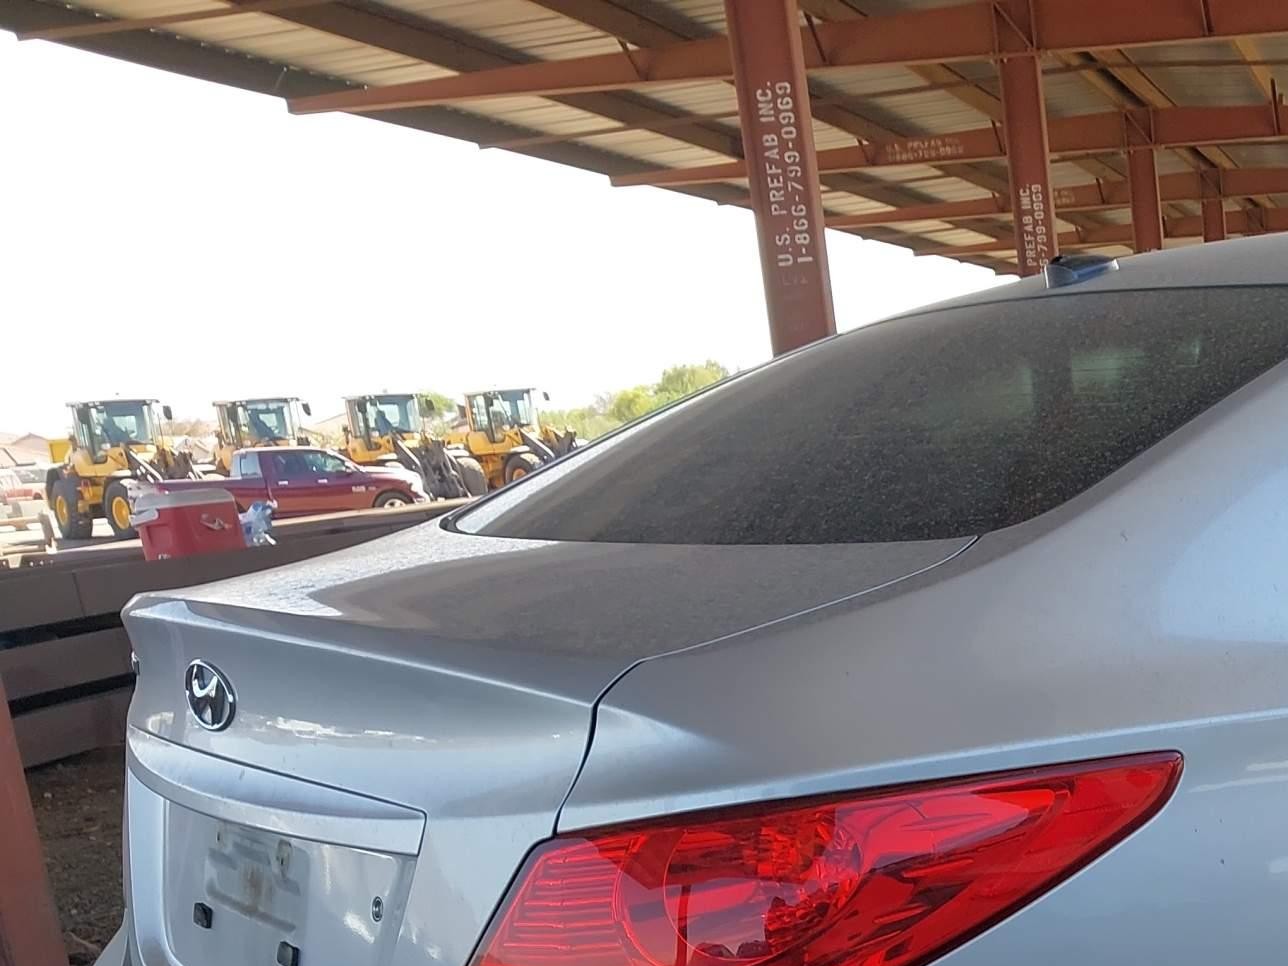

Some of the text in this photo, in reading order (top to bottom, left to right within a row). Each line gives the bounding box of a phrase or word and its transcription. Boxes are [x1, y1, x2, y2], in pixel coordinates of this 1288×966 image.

[755, 81, 793, 267] U.S. PREFAB INC.
[775, 82, 814, 263] 1-866-799-0969
[1022, 215, 1037, 267] PREFAB
